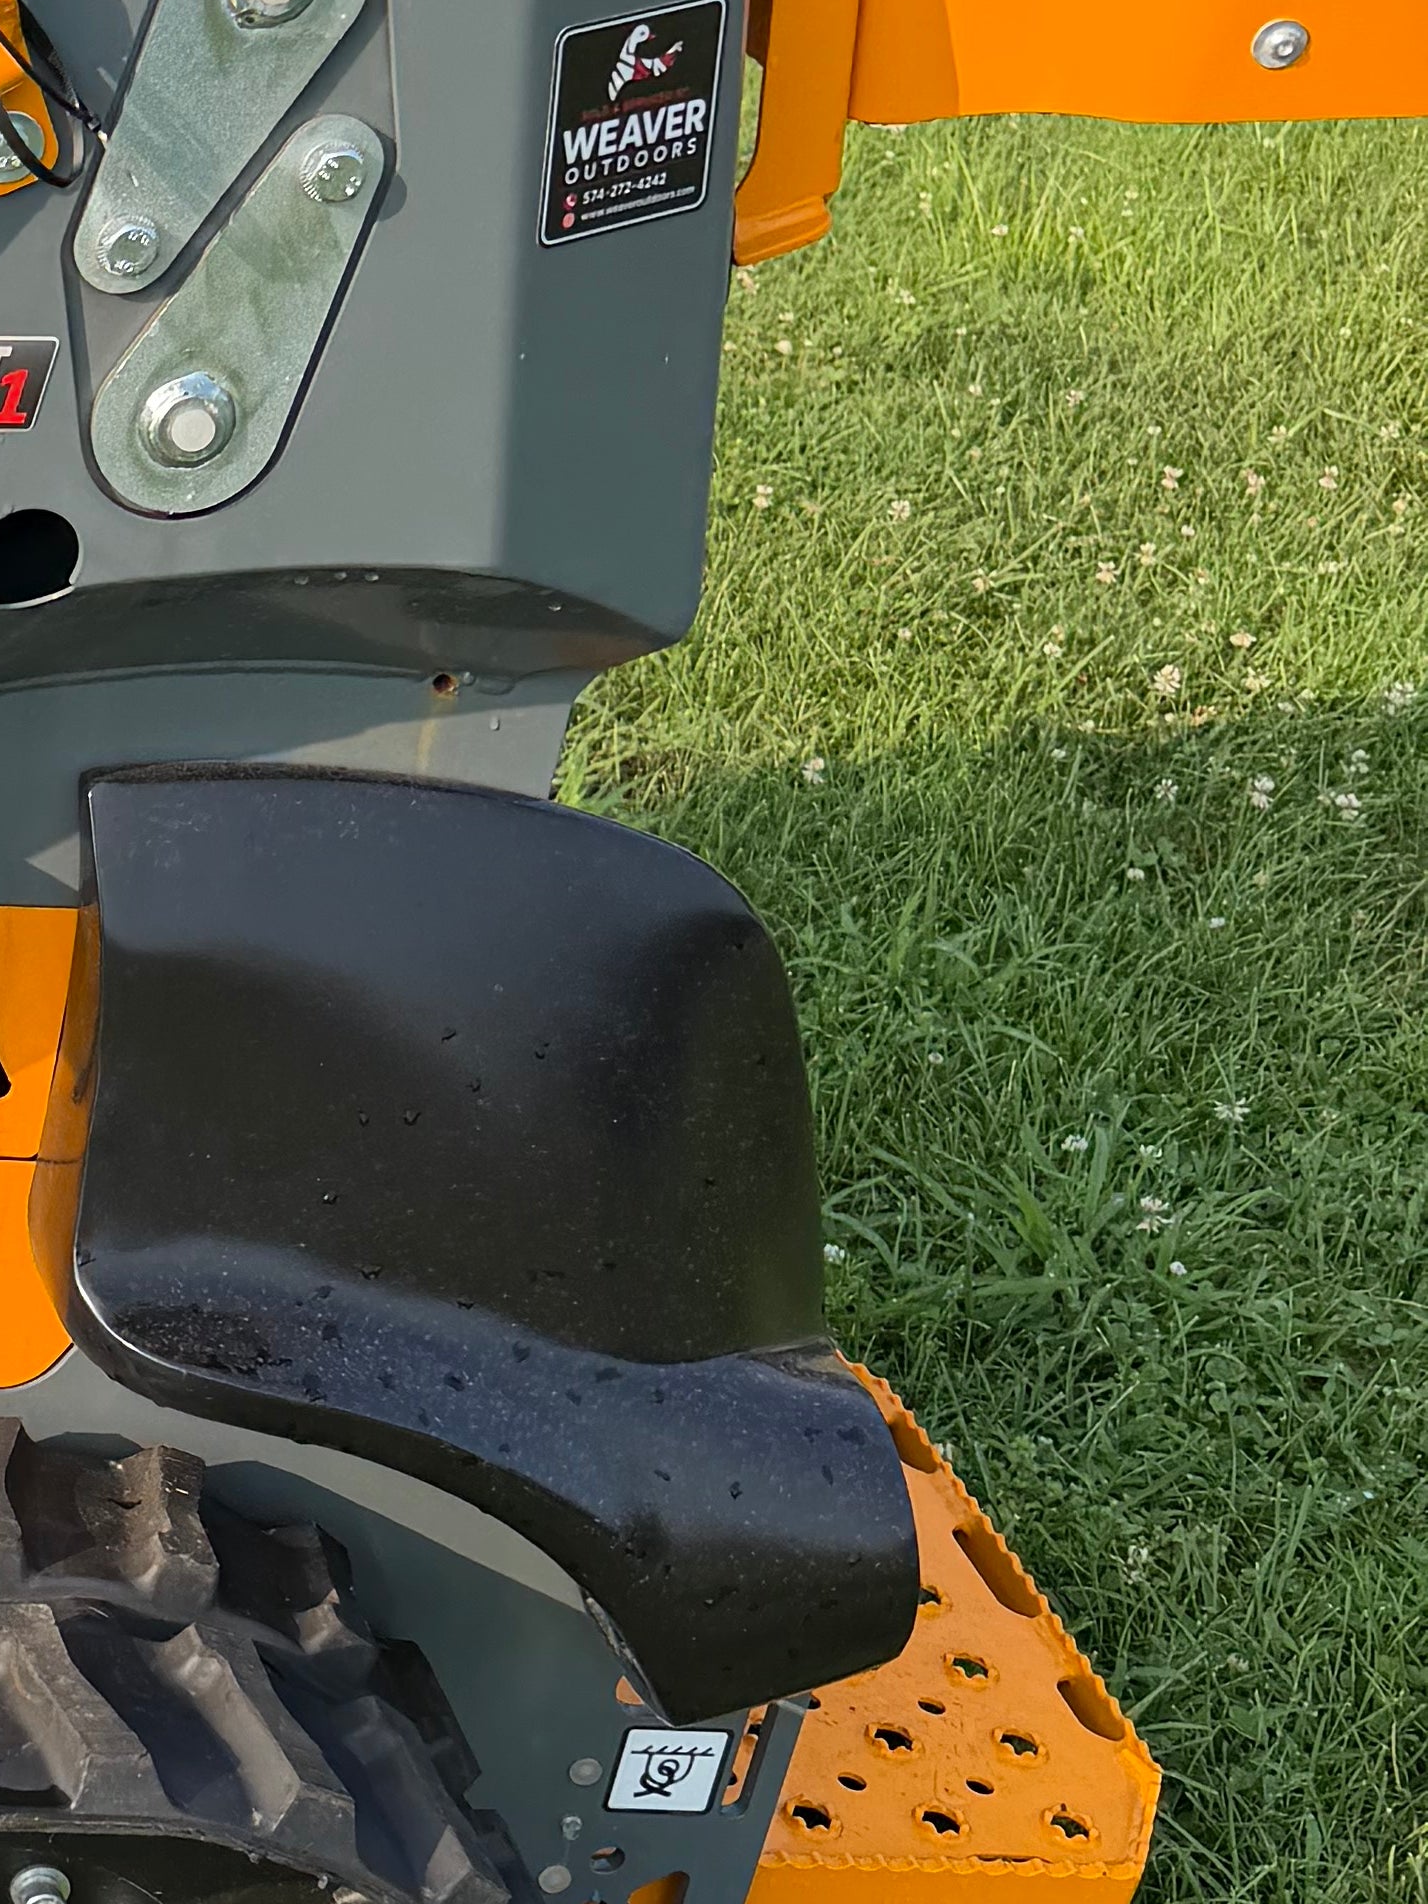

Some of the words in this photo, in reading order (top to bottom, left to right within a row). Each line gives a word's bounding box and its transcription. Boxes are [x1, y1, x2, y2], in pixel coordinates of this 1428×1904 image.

[563, 98, 707, 165] WEAVER
[564, 137, 698, 185] OUTDOORS
[582, 172, 667, 205] 574-272-4242
